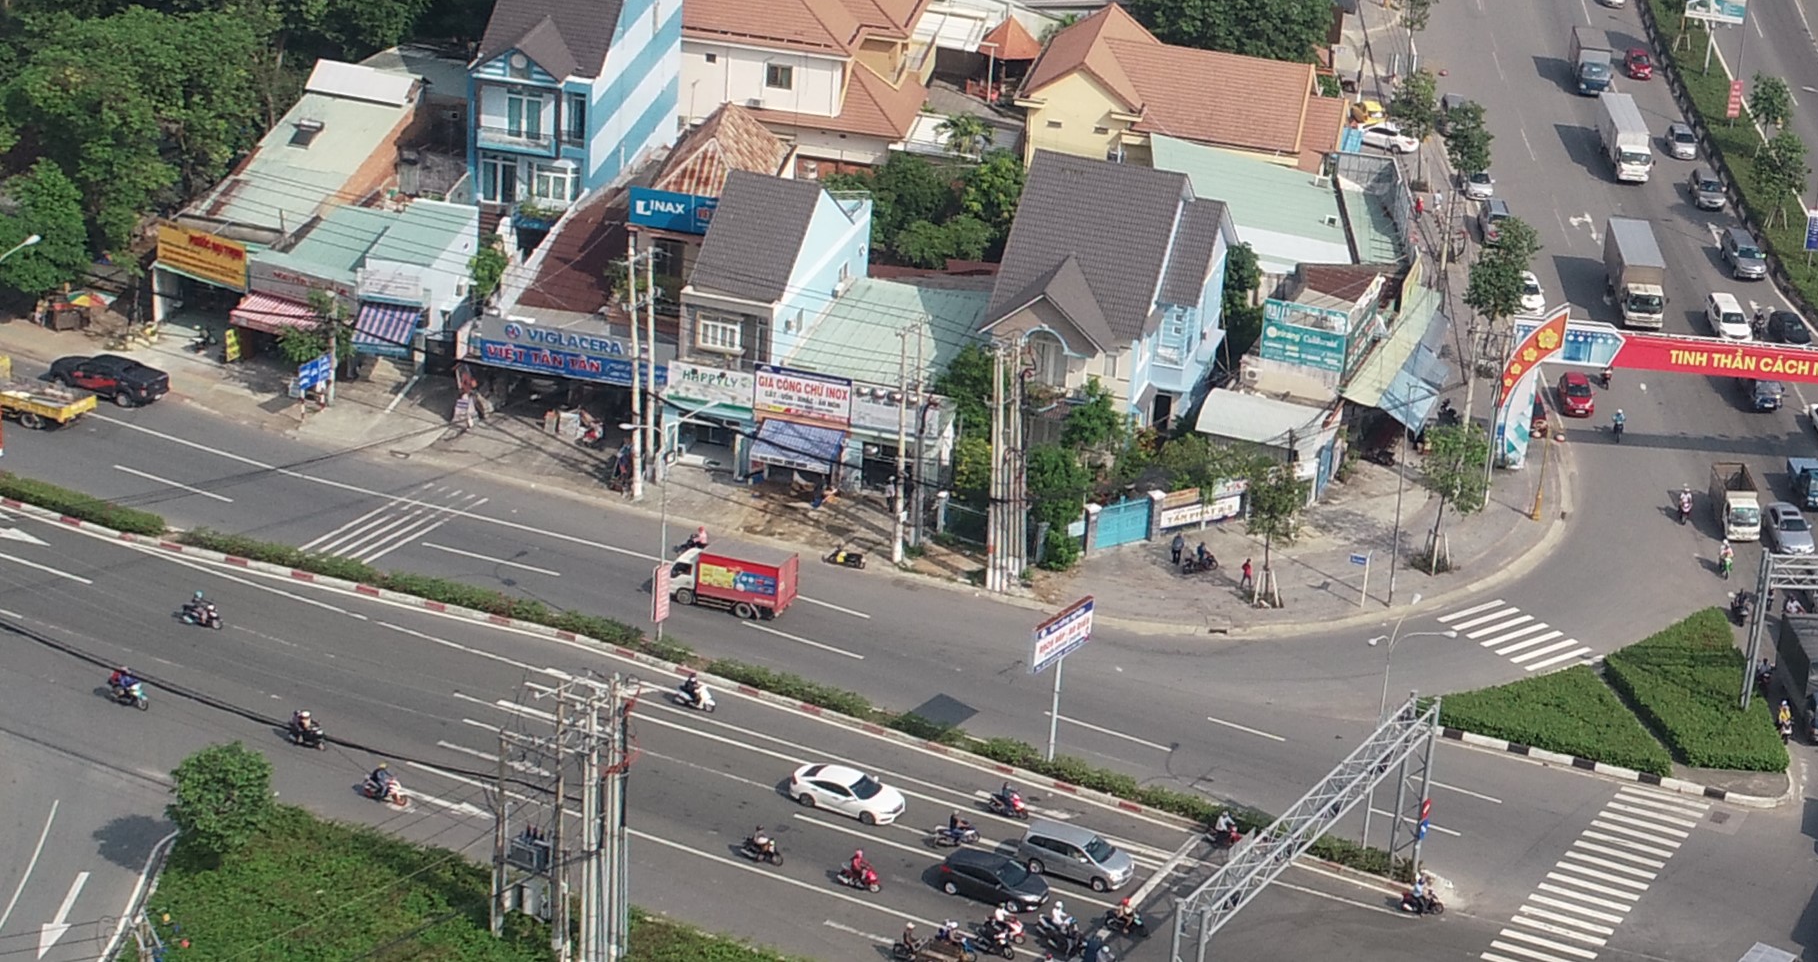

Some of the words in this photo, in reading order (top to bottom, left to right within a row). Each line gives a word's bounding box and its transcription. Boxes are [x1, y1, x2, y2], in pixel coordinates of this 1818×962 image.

[650, 200, 685, 214] INAX
[527, 328, 625, 355] VIGLACERA
[486, 343, 524, 362] VIỆT
[531, 349, 564, 368] TÂN
[569, 355, 602, 373] TÂN
[1670, 350, 1708, 368] TINH
[1712, 348, 1756, 371] THẦN
[1760, 354, 1809, 377] CÁCH
[758, 376, 774, 388] GIA
[776, 378, 802, 393] CÔNG
[804, 382, 823, 397] CHỮ
[825, 386, 848, 401] INOX
